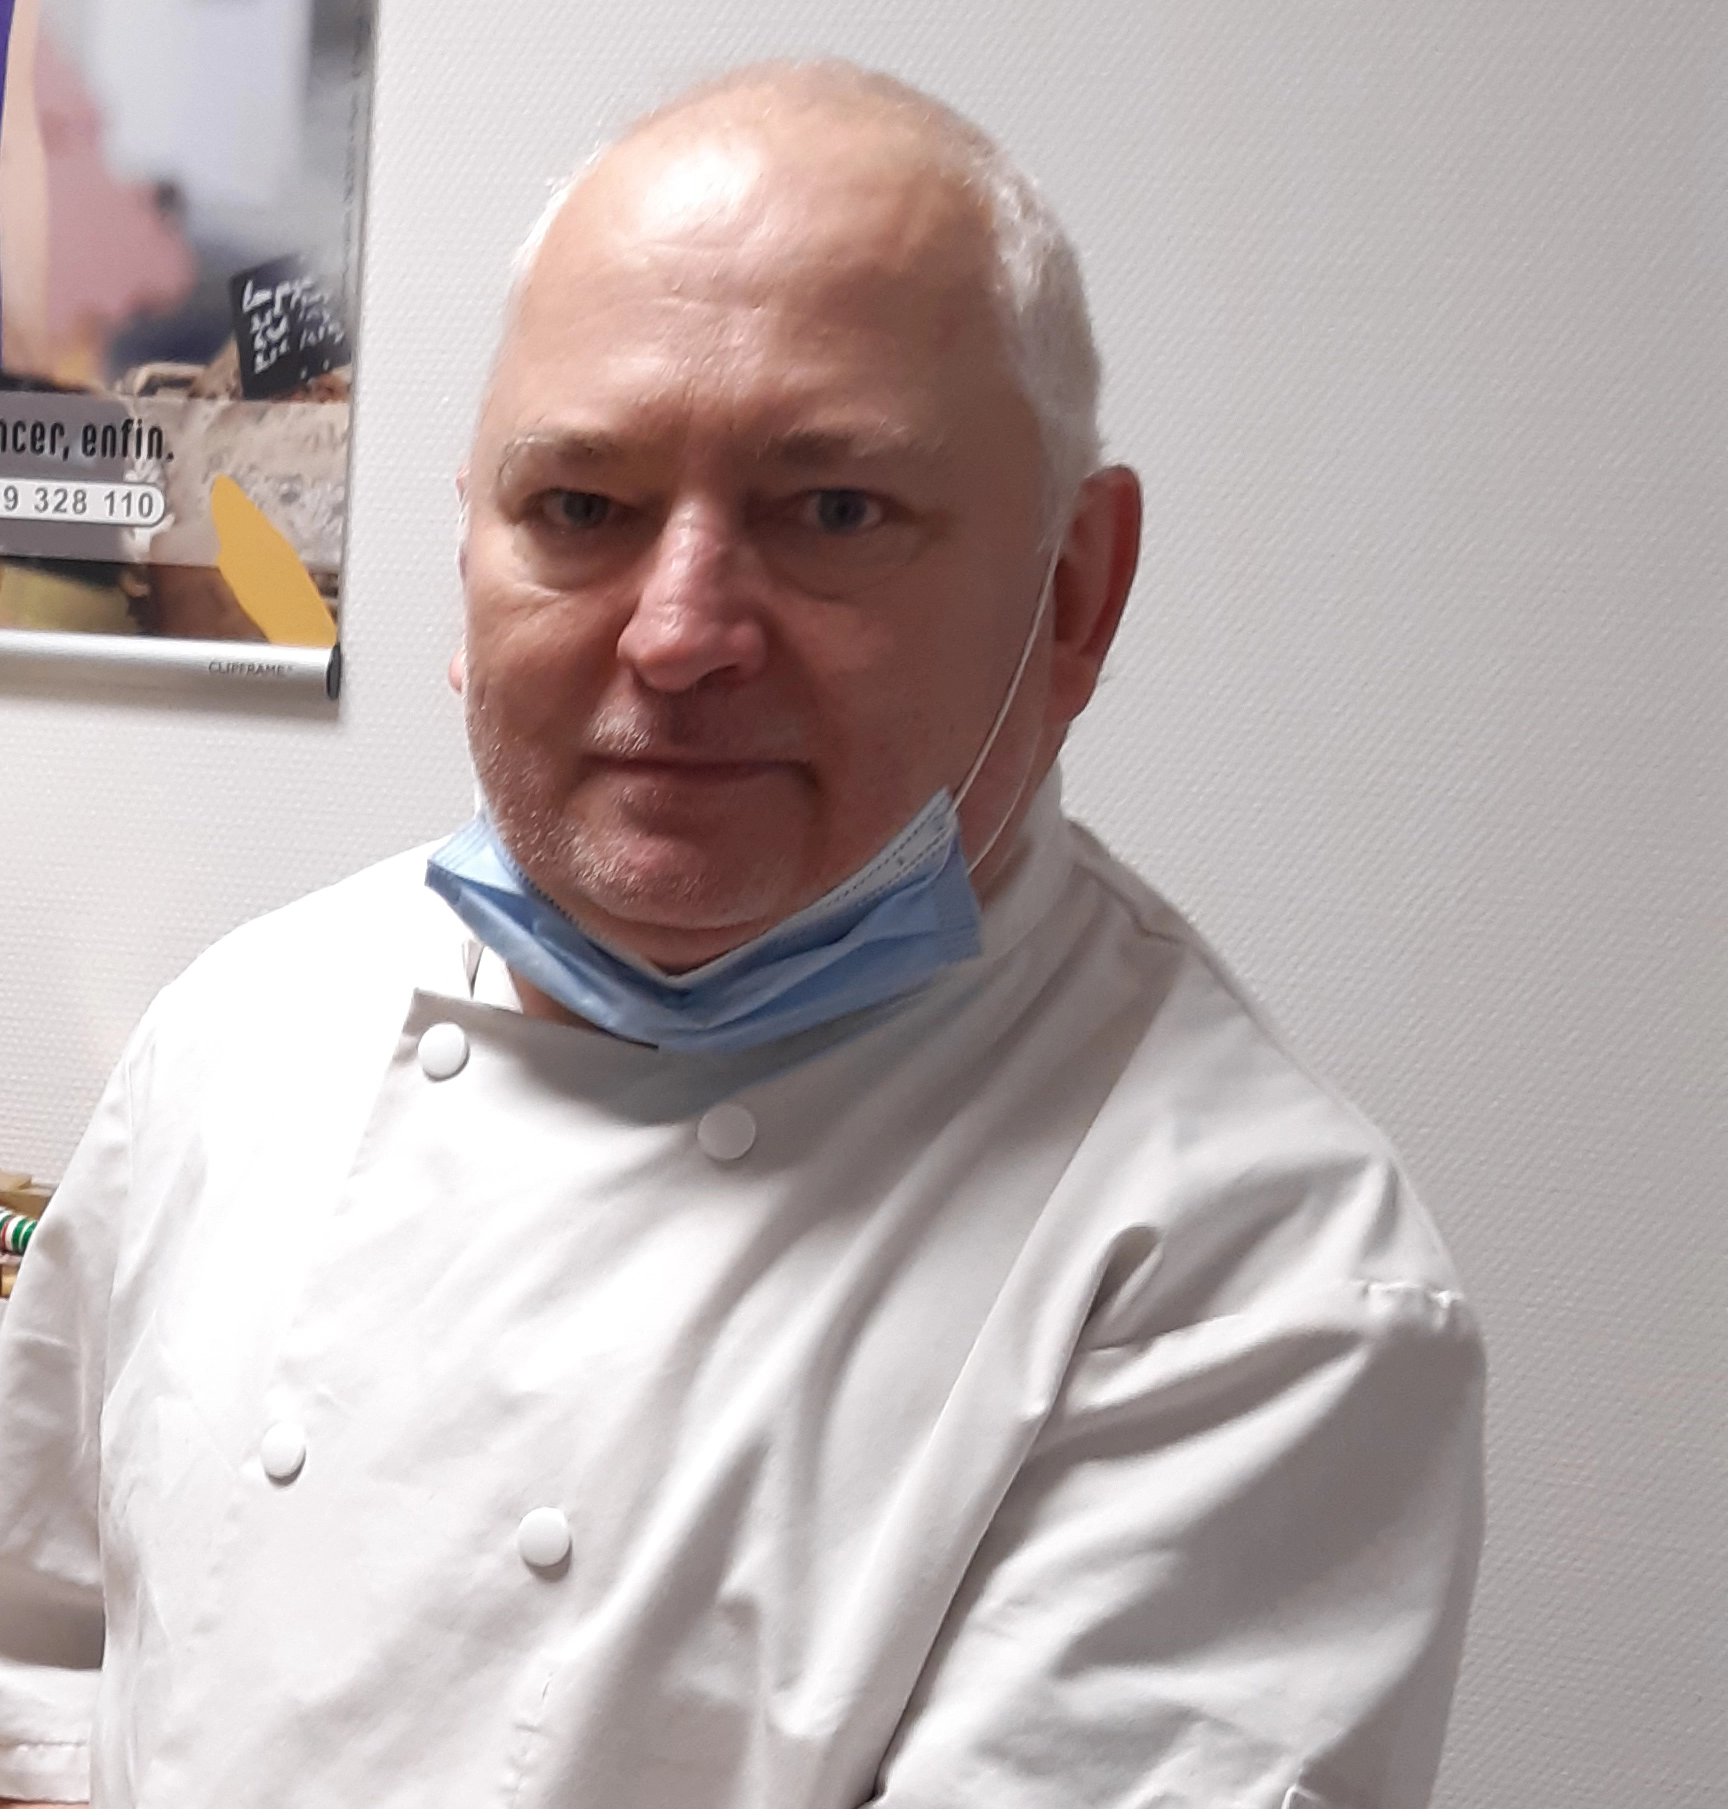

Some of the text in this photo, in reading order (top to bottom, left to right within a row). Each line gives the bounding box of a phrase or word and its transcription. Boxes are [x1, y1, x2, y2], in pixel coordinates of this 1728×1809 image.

[81, 417, 174, 461] enfin.
[33, 486, 88, 515] 328
[103, 490, 154, 519] 110
